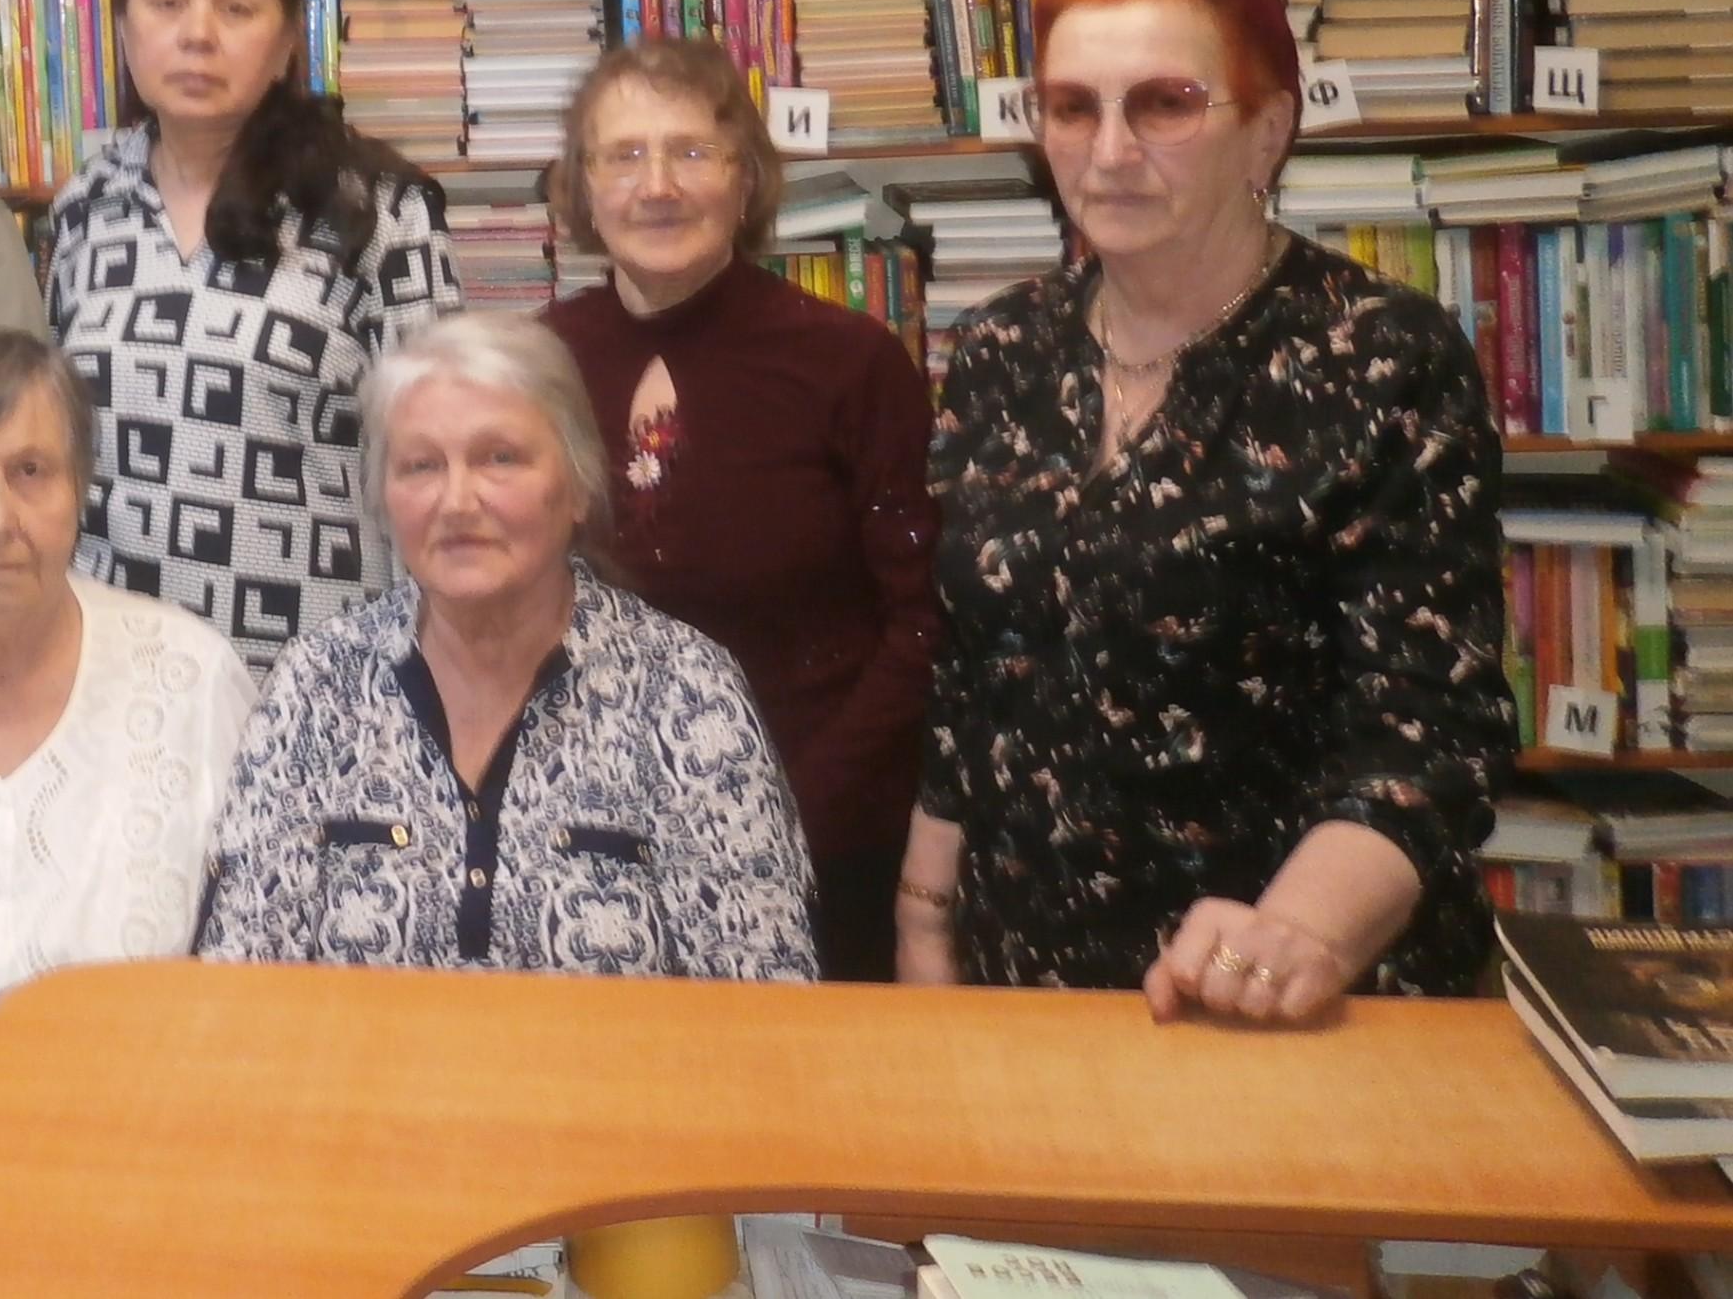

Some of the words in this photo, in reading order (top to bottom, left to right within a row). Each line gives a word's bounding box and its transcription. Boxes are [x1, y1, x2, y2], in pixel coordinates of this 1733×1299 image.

[1308, 77, 1339, 107] Ф
[1547, 67, 1584, 104] Щ
[787, 106, 811, 137] И
[998, 93, 1020, 123] К
[1587, 395, 1606, 426] Г
[1564, 703, 1598, 737] М
